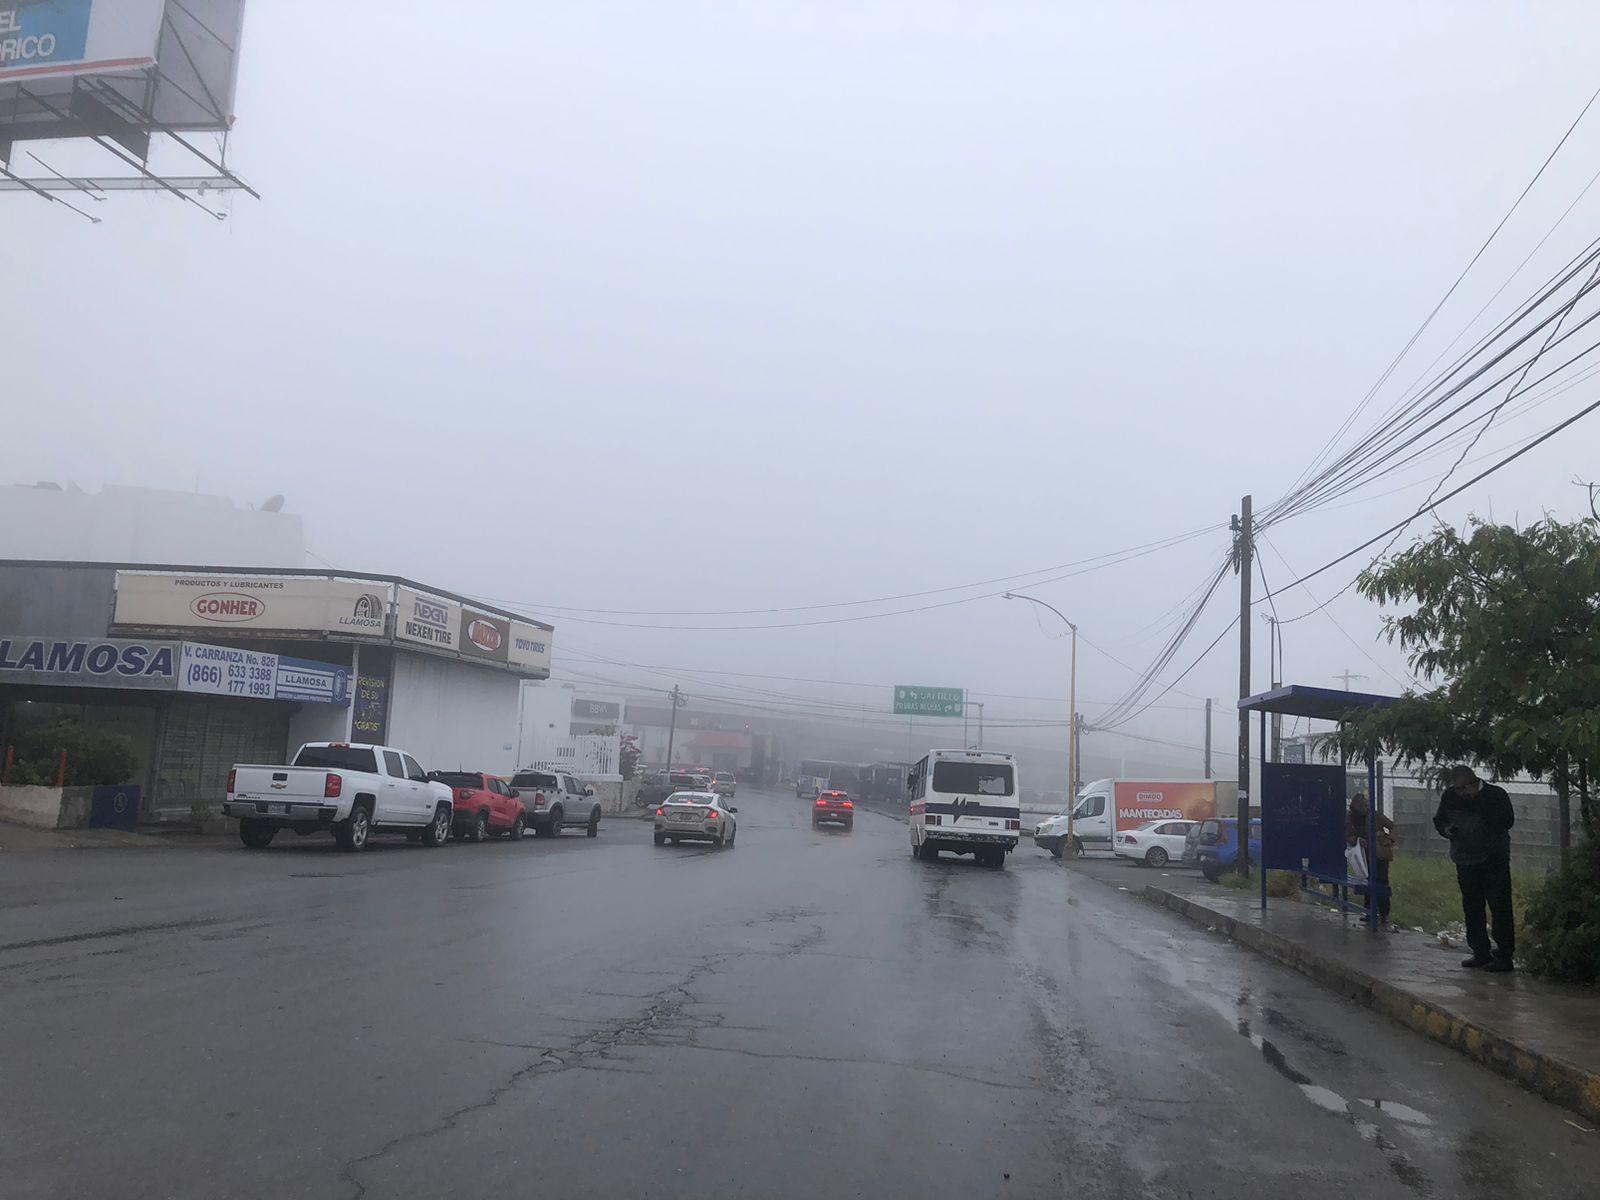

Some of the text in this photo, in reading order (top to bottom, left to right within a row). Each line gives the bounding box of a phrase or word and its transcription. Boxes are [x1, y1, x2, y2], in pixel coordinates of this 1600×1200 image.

[0, 33, 56, 61] RICO
[174, 579, 221, 588] PRODUCTOS
[230, 581, 284, 590] LUBRICANTES
[196, 599, 258, 616] GONHER
[413, 601, 449, 624] NEXEN
[338, 616, 382, 628] LLAMOSA
[405, 621, 433, 640] NEXEN
[434, 628, 452, 645] TIRE
[515, 637, 545, 653] TOYO TIRES
[184, 645, 276, 668] V. CARRANZA No. 826
[187, 663, 222, 688] (866)
[228, 664, 272, 681] 633 3388
[285, 674, 327, 688] LLAMOSA
[227, 679, 271, 696] 177 1993
[1119, 807, 1183, 819] MANTECADAS
